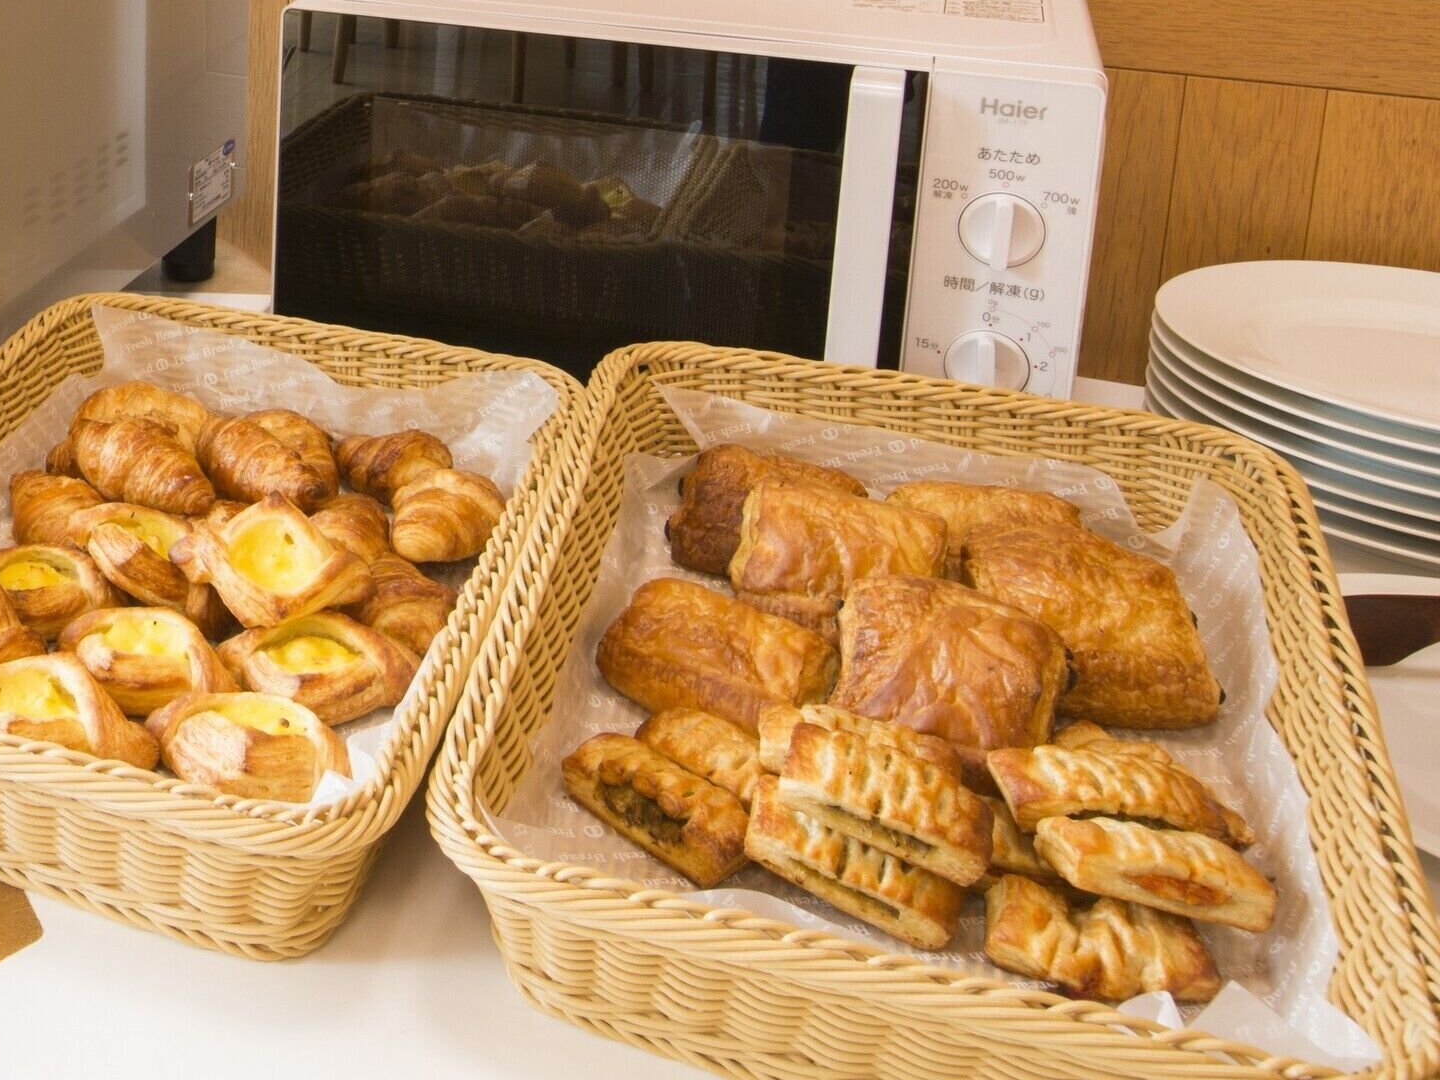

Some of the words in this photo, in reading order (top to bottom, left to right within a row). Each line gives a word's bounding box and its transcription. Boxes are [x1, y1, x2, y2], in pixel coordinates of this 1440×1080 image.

[979, 96, 1048, 120] Haier
[976, 146, 1041, 165] あたため
[932, 190, 953, 200] 解凍
[982, 311, 1001, 324] 0分
[125, 336, 153, 354] Fresh
[155, 326, 183, 343] Bread
[915, 337, 939, 351] 15分
[1026, 332, 1031, 343] 1
[173, 348, 200, 367] Fresh
[202, 338, 235, 359] Bread
[1039, 361, 1049, 372] 2
[478, 392, 506, 419] Fresh
[720, 422, 753, 439] Fresh
[845, 445, 883, 463] Fresh
[870, 470, 908, 488] Bread
[912, 462, 950, 480] Fresh
